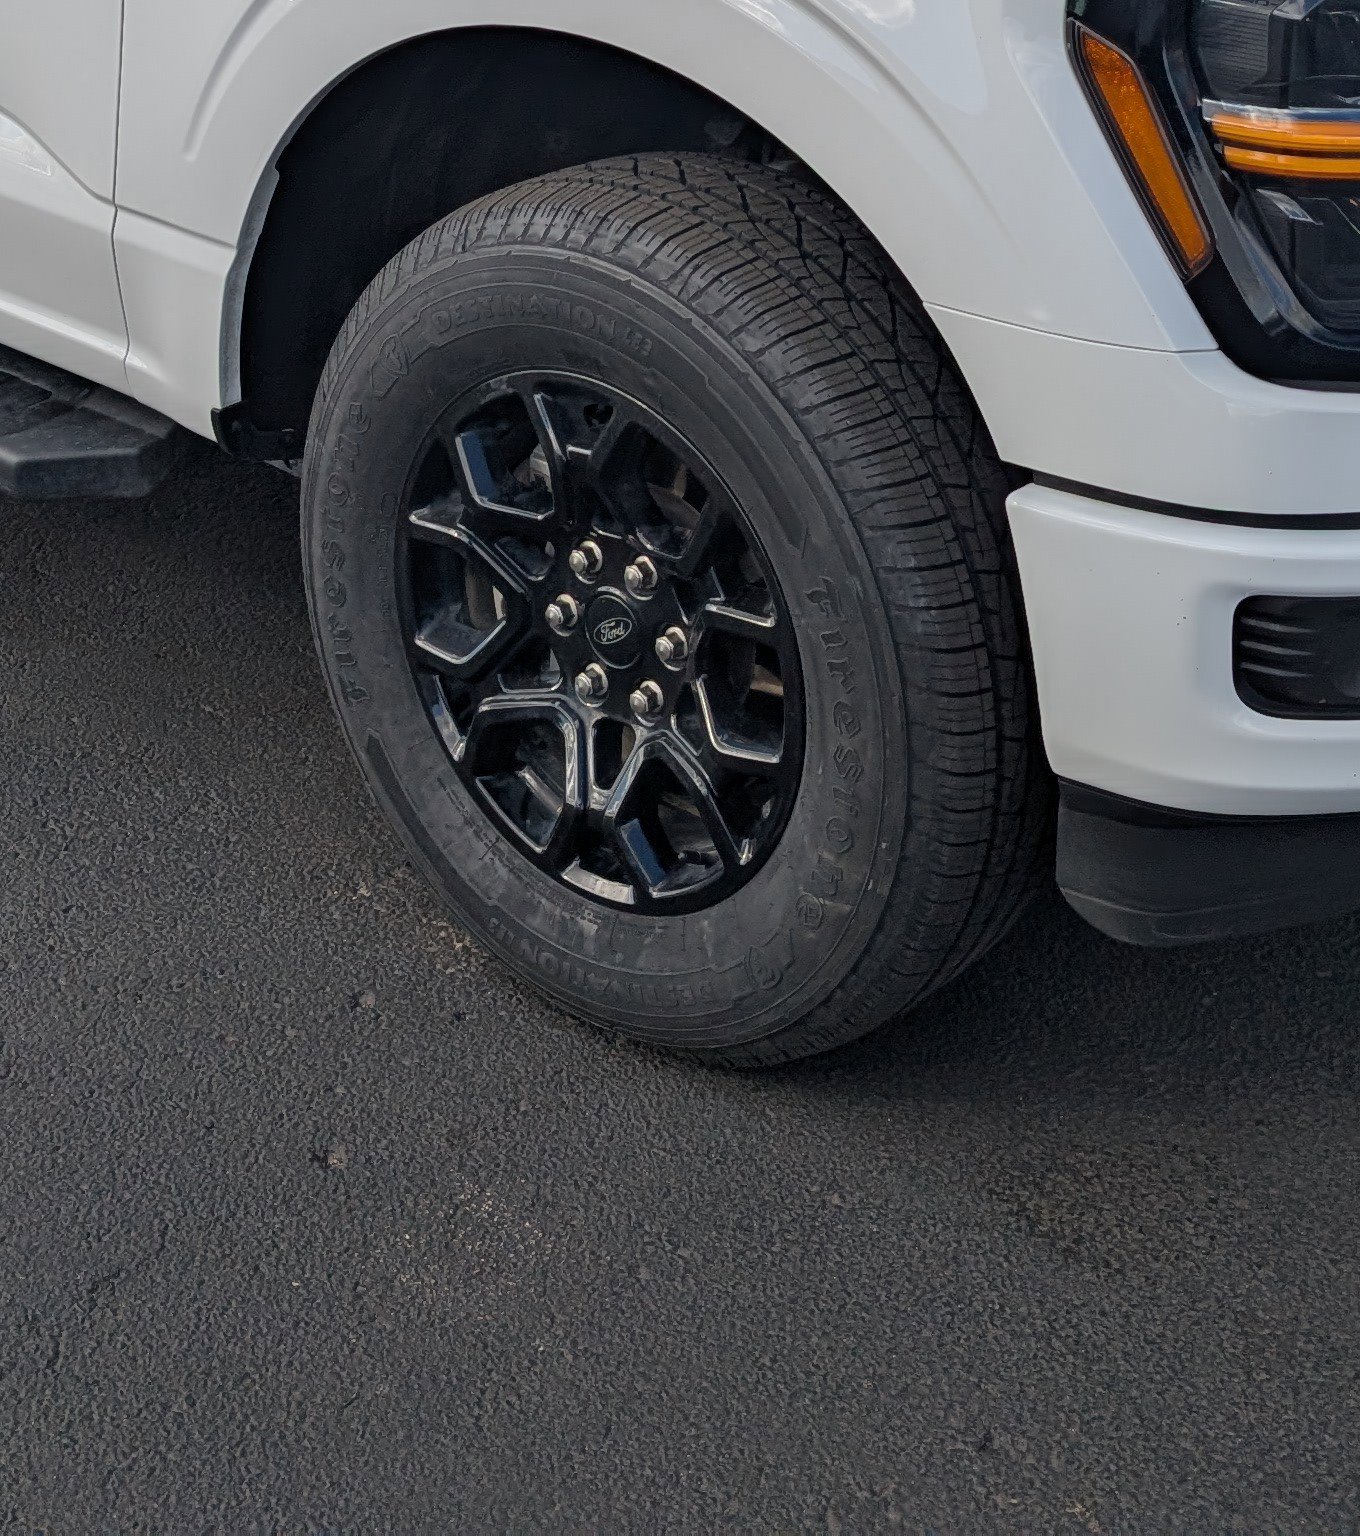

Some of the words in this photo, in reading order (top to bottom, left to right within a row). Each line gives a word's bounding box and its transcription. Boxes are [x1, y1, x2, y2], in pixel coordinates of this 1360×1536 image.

[321, 400, 372, 706] Firestone
[600, 621, 625, 642] Ford
[796, 574, 864, 930] Firestone
